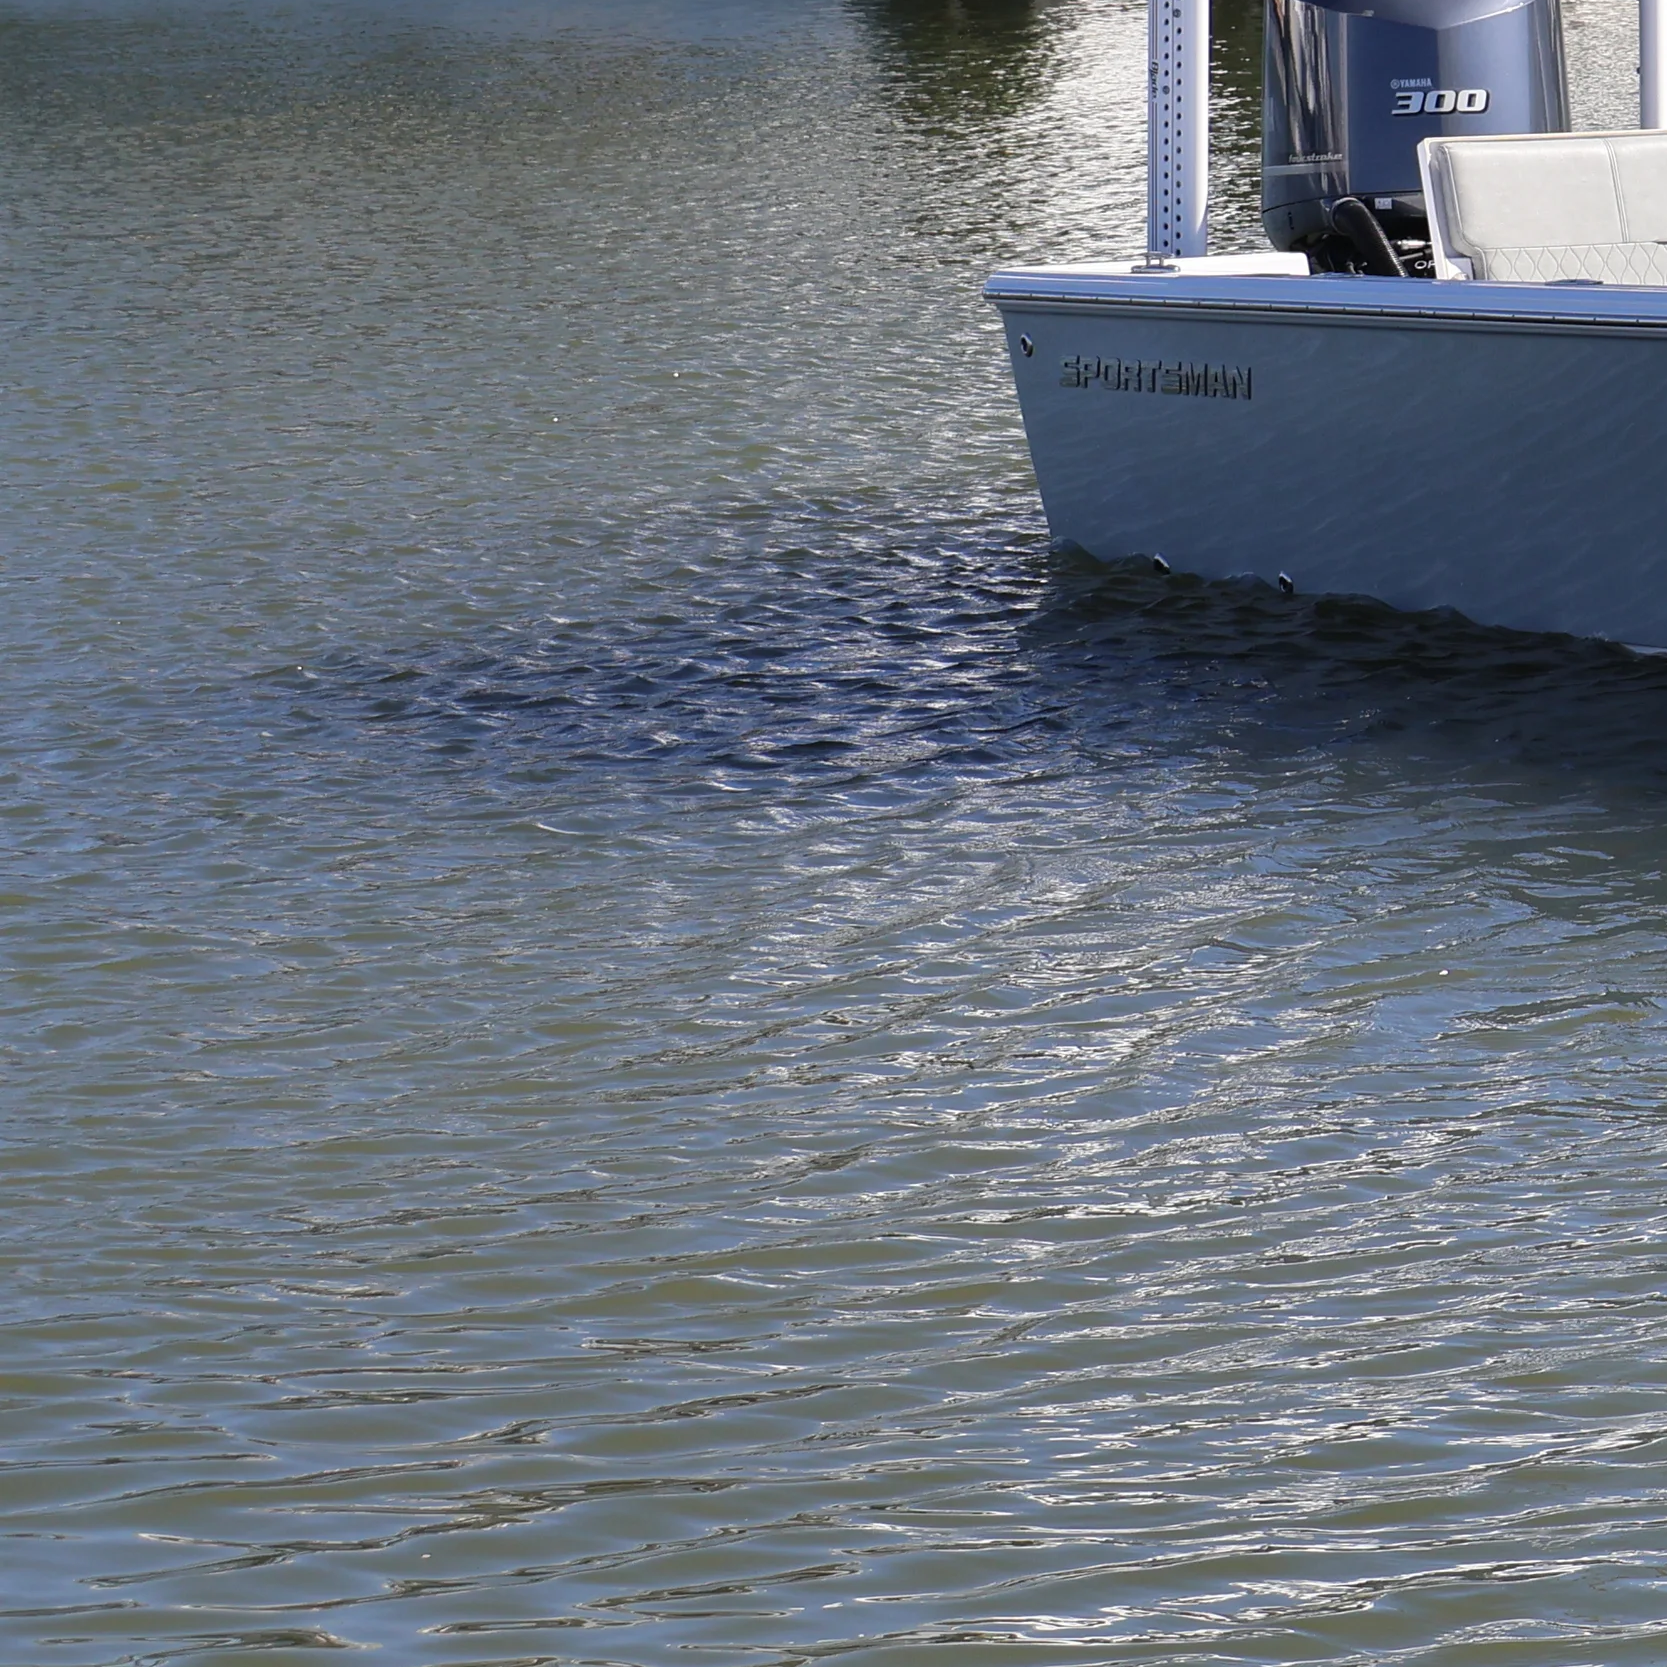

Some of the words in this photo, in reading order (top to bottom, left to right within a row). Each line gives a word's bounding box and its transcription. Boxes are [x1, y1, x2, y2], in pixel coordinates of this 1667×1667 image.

[1400, 78, 1432, 88] YAMAHA
[1391, 89, 1489, 115] 300
[1059, 355, 1252, 400] SPORTSMAN
